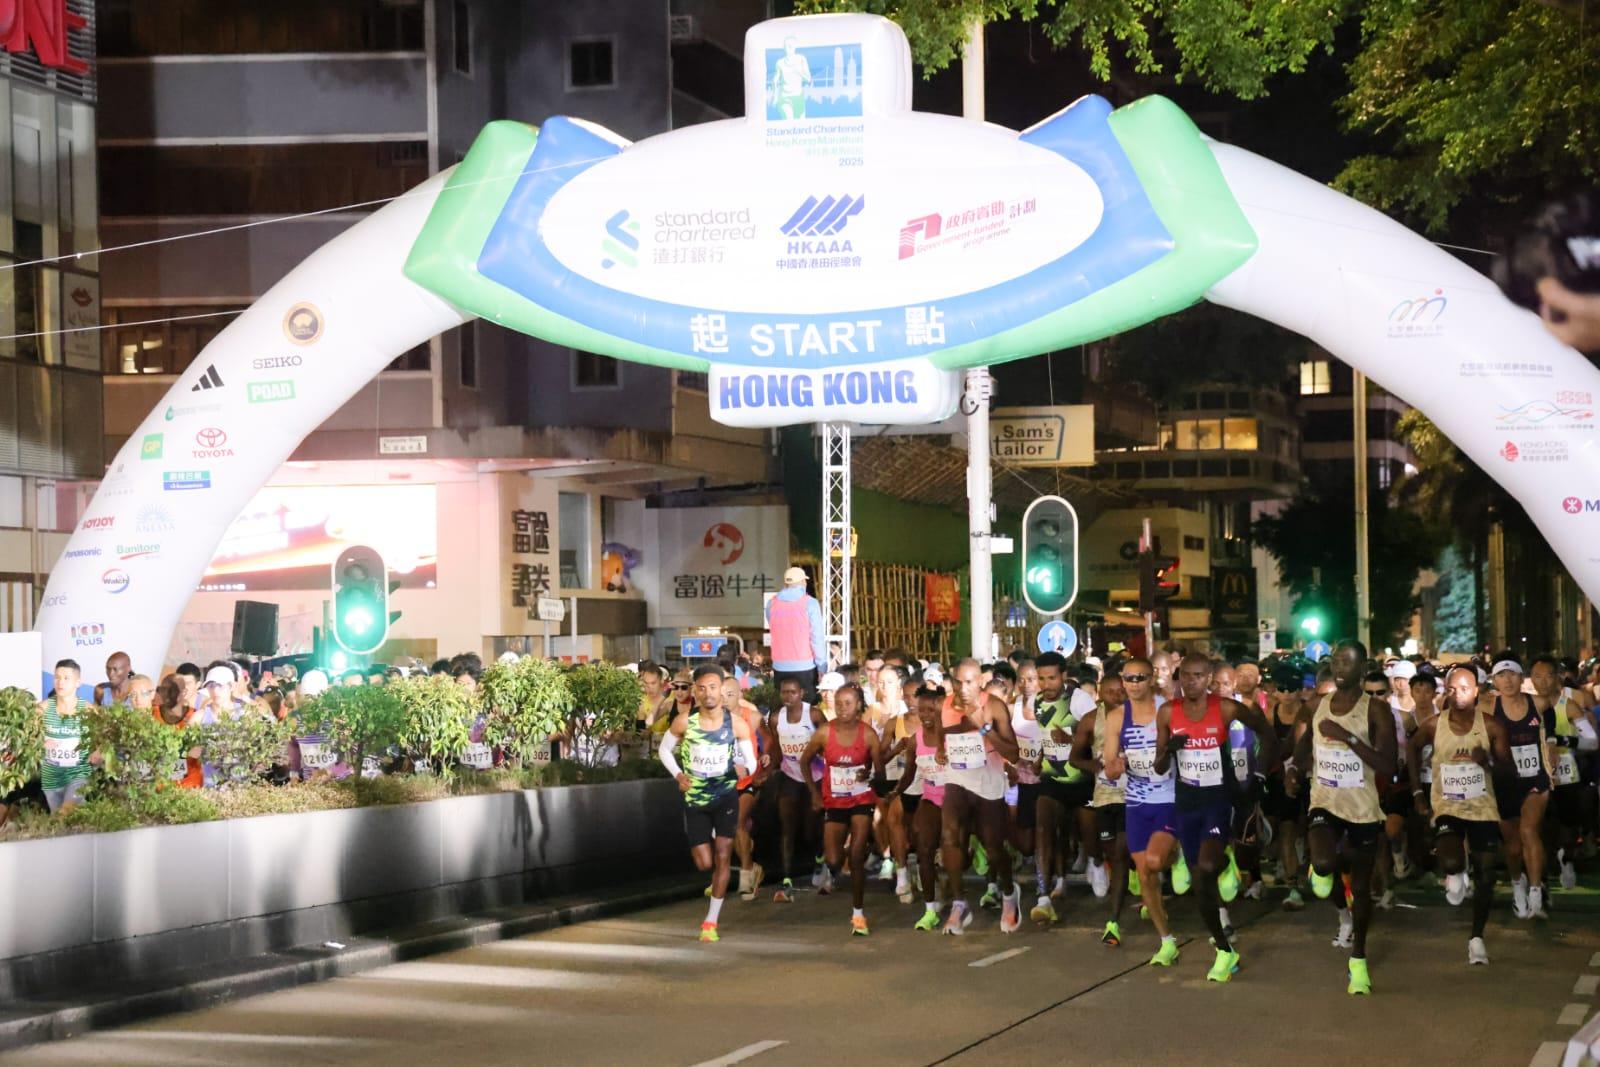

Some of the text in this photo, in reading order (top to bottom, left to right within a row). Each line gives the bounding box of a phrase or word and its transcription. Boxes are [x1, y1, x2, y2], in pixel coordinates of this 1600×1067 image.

[0, 0, 89, 75] NE
[765, 124, 864, 137] Standard Chartered
[838, 157, 864, 167] 2025
[654, 207, 751, 229] standard
[654, 223, 757, 245] chartered
[787, 239, 853, 255] HKAAA
[653, 247, 726, 265] 渣打銀行
[690, 306, 946, 357] 起 START 點
[252, 355, 303, 370] SEIKO
[251, 383, 291, 399] POAD
[719, 370, 918, 410] HONG KONG
[1003, 422, 1054, 439] Sam's
[192, 449, 234, 459] TOYOTA
[116, 543, 161, 555] Banitore
[674, 573, 776, 599] 富途牛牛
[76, 637, 103, 646] PLUS
[1183, 737, 1218, 748] ENYA
[692, 754, 726, 765] AYALE
[1180, 760, 1220, 772] KIPYEKO
[1517, 757, 1538, 769] 103
[1319, 760, 1360, 773] KIPRONO
[1552, 764, 1571, 776] 216
[1443, 773, 1484, 786] KIPKOSGEI
